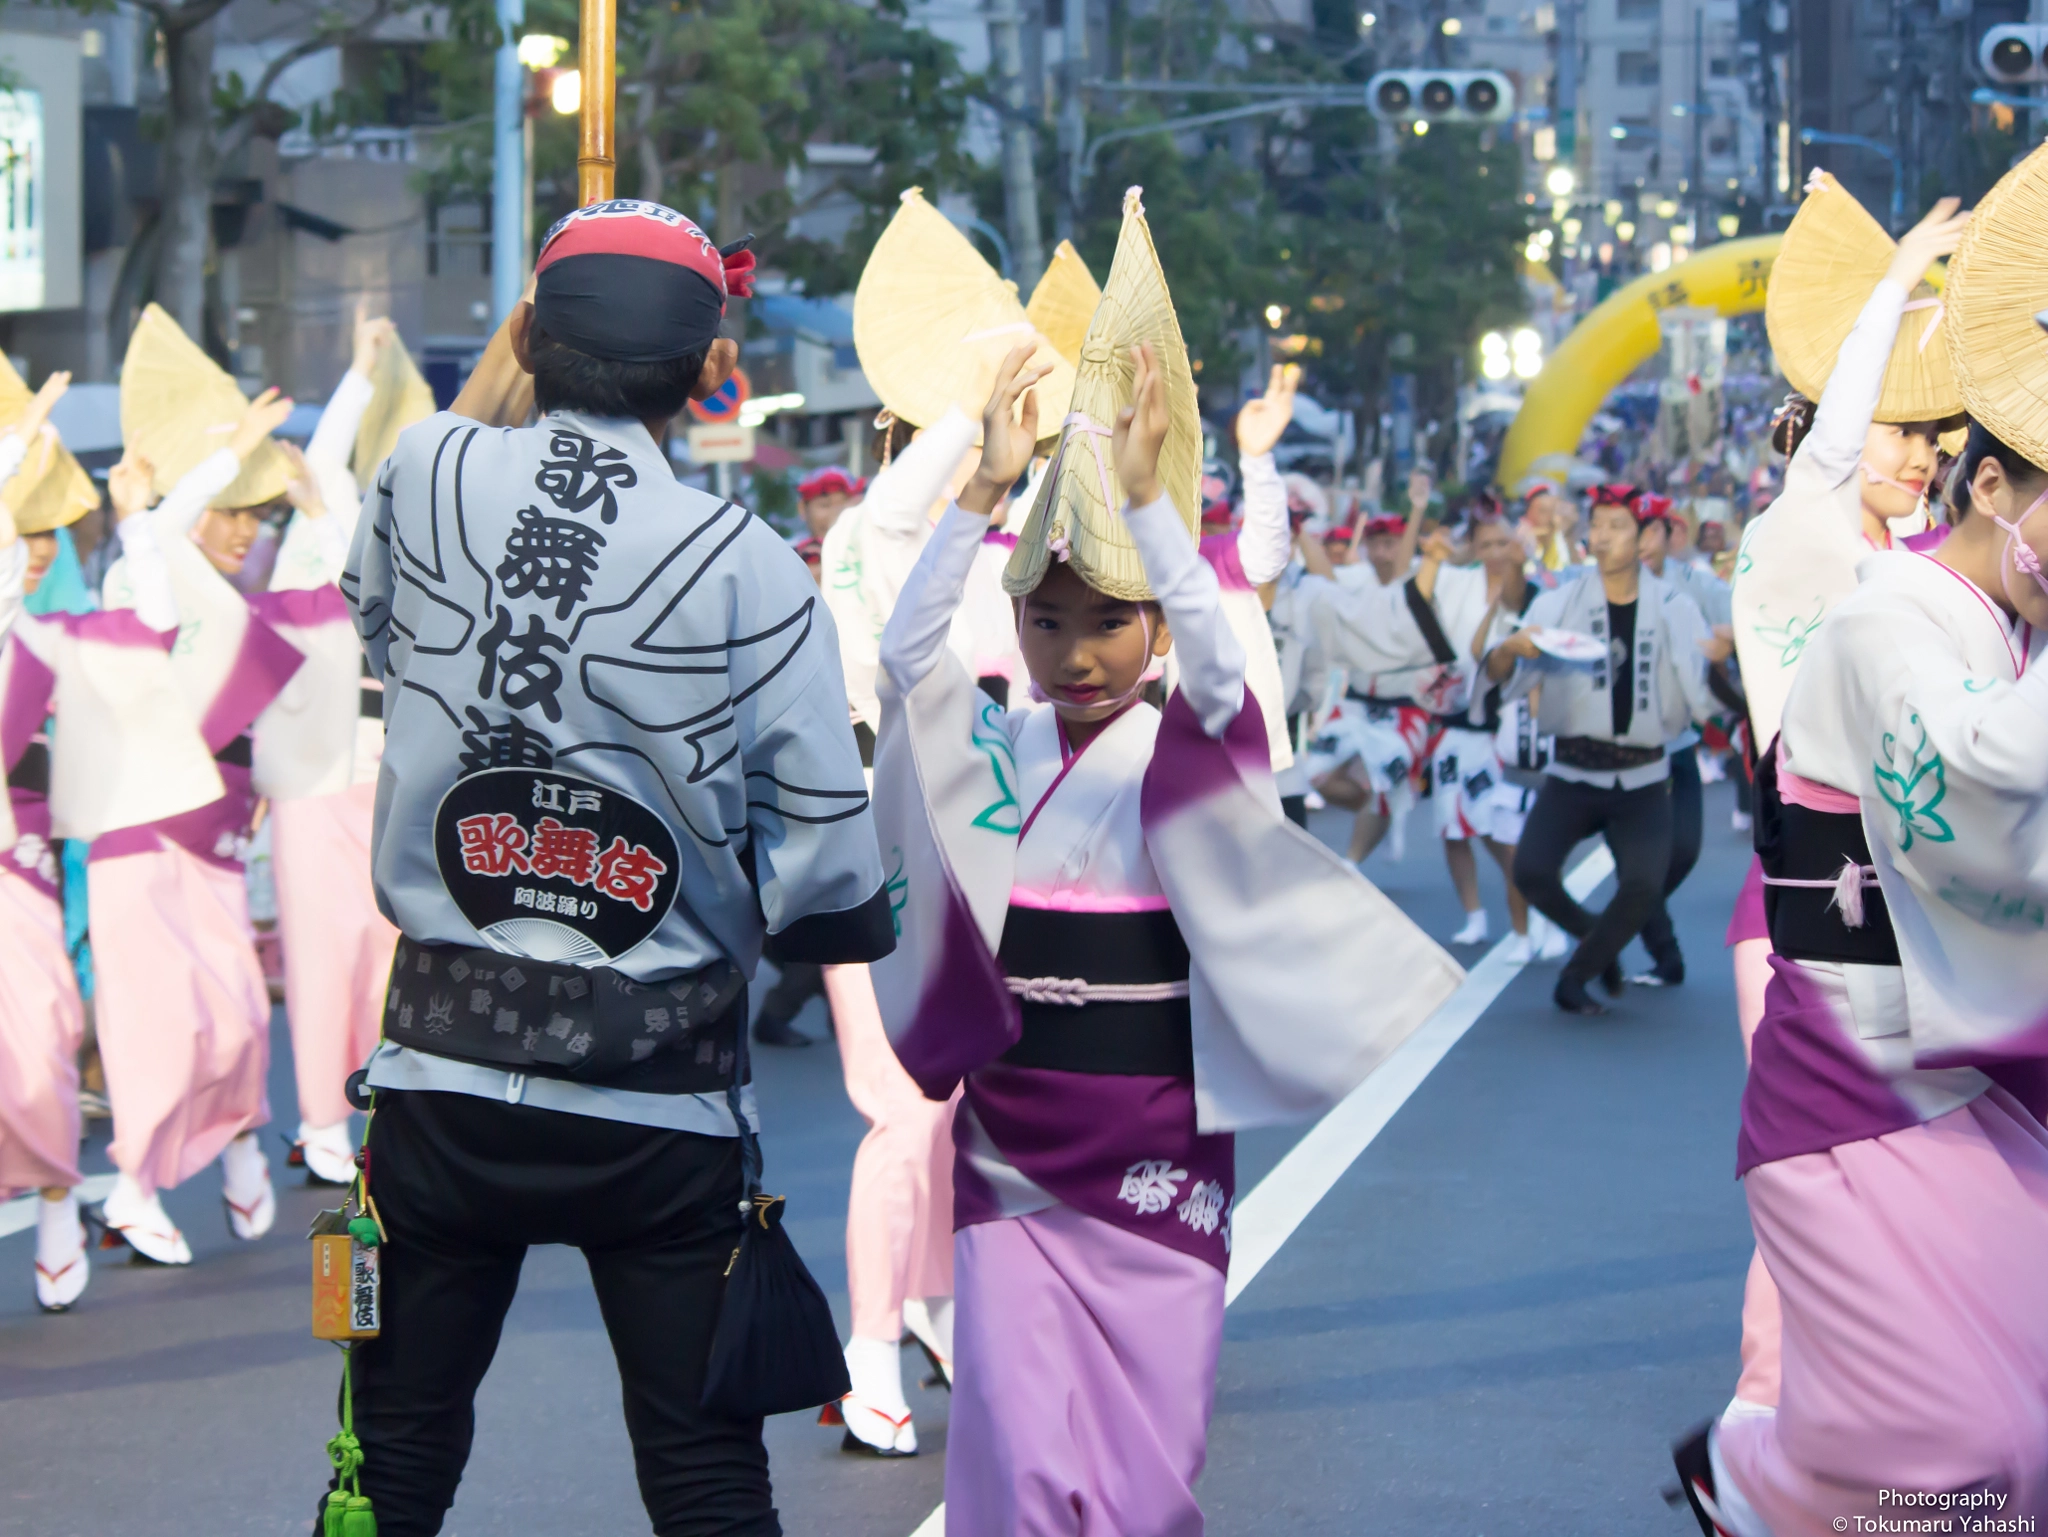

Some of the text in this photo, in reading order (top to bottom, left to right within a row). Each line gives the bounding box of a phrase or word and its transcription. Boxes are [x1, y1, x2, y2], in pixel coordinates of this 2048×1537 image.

[531, 779, 603, 816] 江戸
[457, 812, 667, 912] 歌舞伎
[513, 886, 598, 920] 阿波踊り
